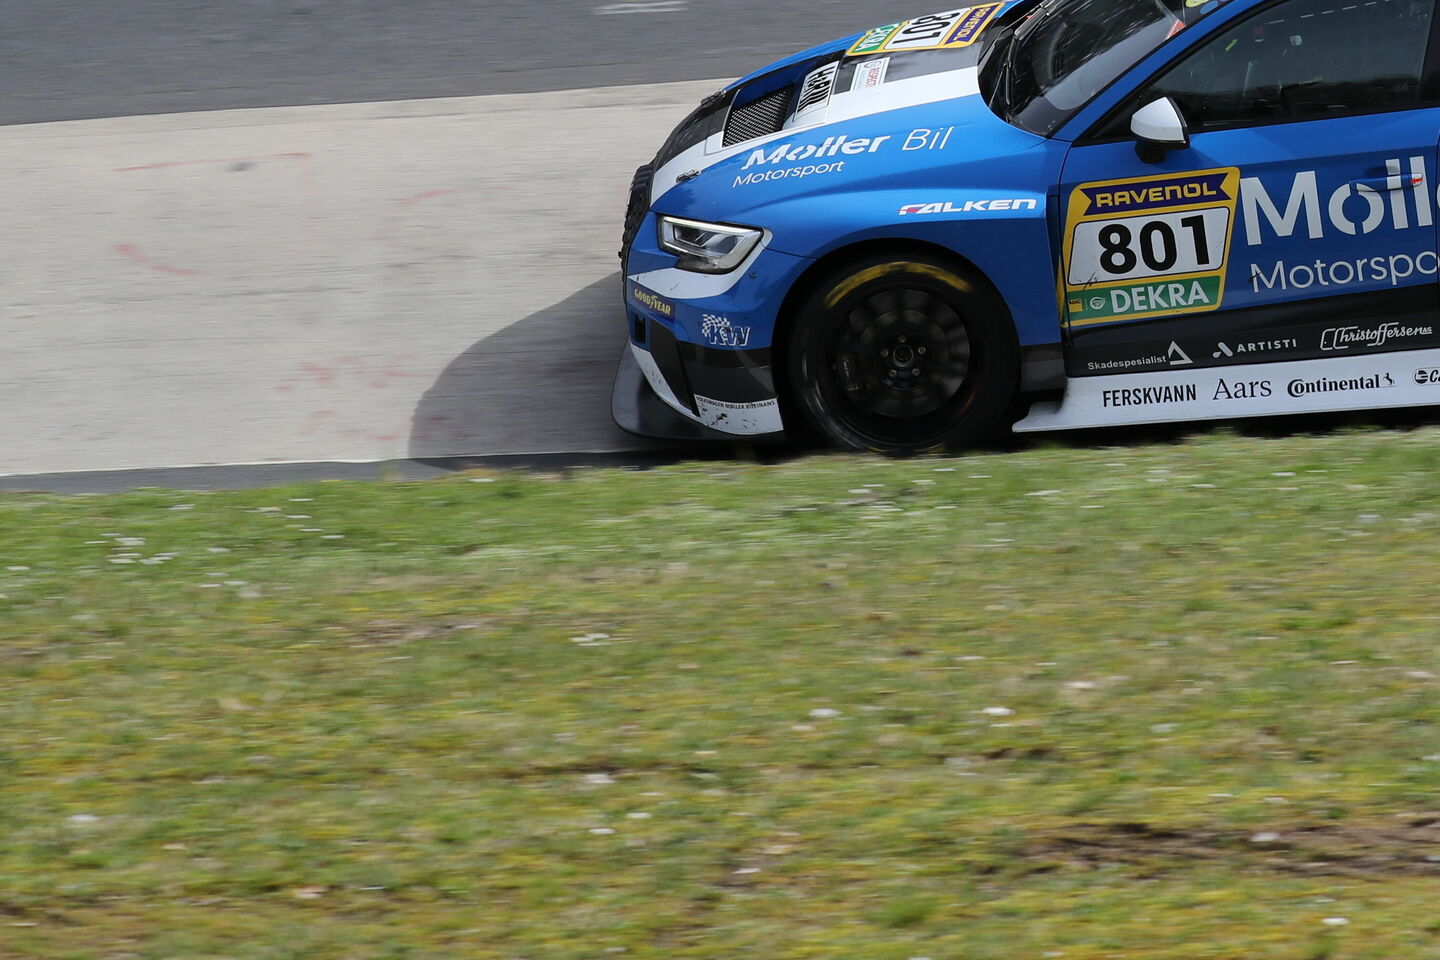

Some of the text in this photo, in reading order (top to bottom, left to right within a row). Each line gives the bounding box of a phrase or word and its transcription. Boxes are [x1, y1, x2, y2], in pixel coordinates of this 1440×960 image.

[893, 12, 961, 45] 801
[901, 125, 955, 151] Bil
[732, 159, 846, 188] Motorsport
[897, 198, 1037, 215] FALKEN
[1095, 182, 1217, 208] RAVENOL
[1098, 214, 1210, 275] 801
[1110, 280, 1210, 314] DEKRA
[708, 325, 751, 347] KW
[1237, 339, 1298, 353] ARTISTI
[1087, 355, 1167, 370] Skadespesialist
[1102, 383, 1198, 408] FERSKVANN
[1212, 378, 1273, 402] Aars
[1287, 374, 1381, 398] Continental
